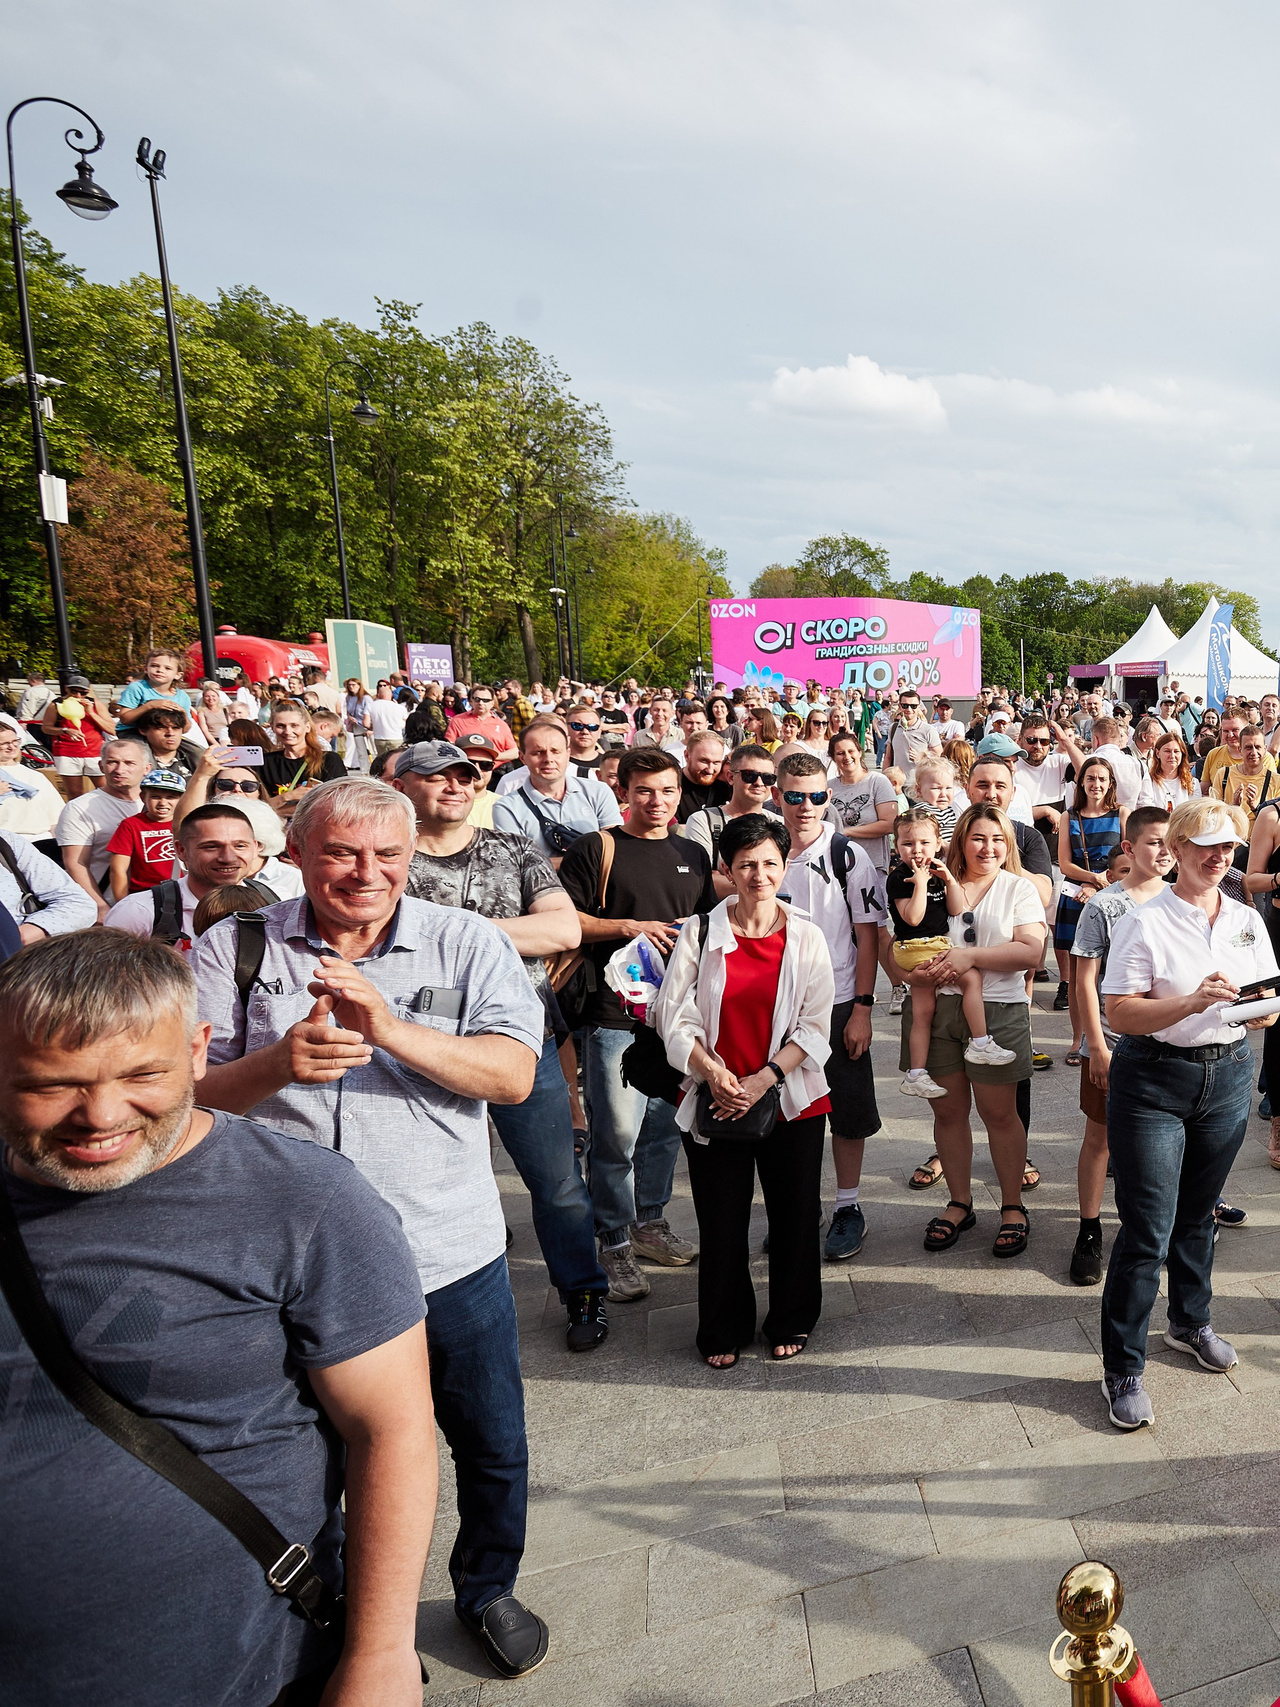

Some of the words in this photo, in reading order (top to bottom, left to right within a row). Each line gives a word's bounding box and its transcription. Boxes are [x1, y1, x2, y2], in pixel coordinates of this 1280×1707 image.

[711, 603, 756, 618] OZON
[953, 611, 981, 626] OZO
[754, 620, 795, 652] О!
[801, 616, 886, 642] СКОРО
[816, 643, 895, 659] ГРАНДИОЗНЫЕ
[896, 641, 928, 654] СКИДКИ
[412, 658, 450, 669] ЛЕТО
[840, 660, 893, 692] ДО
[898, 657, 940, 686] 80%
